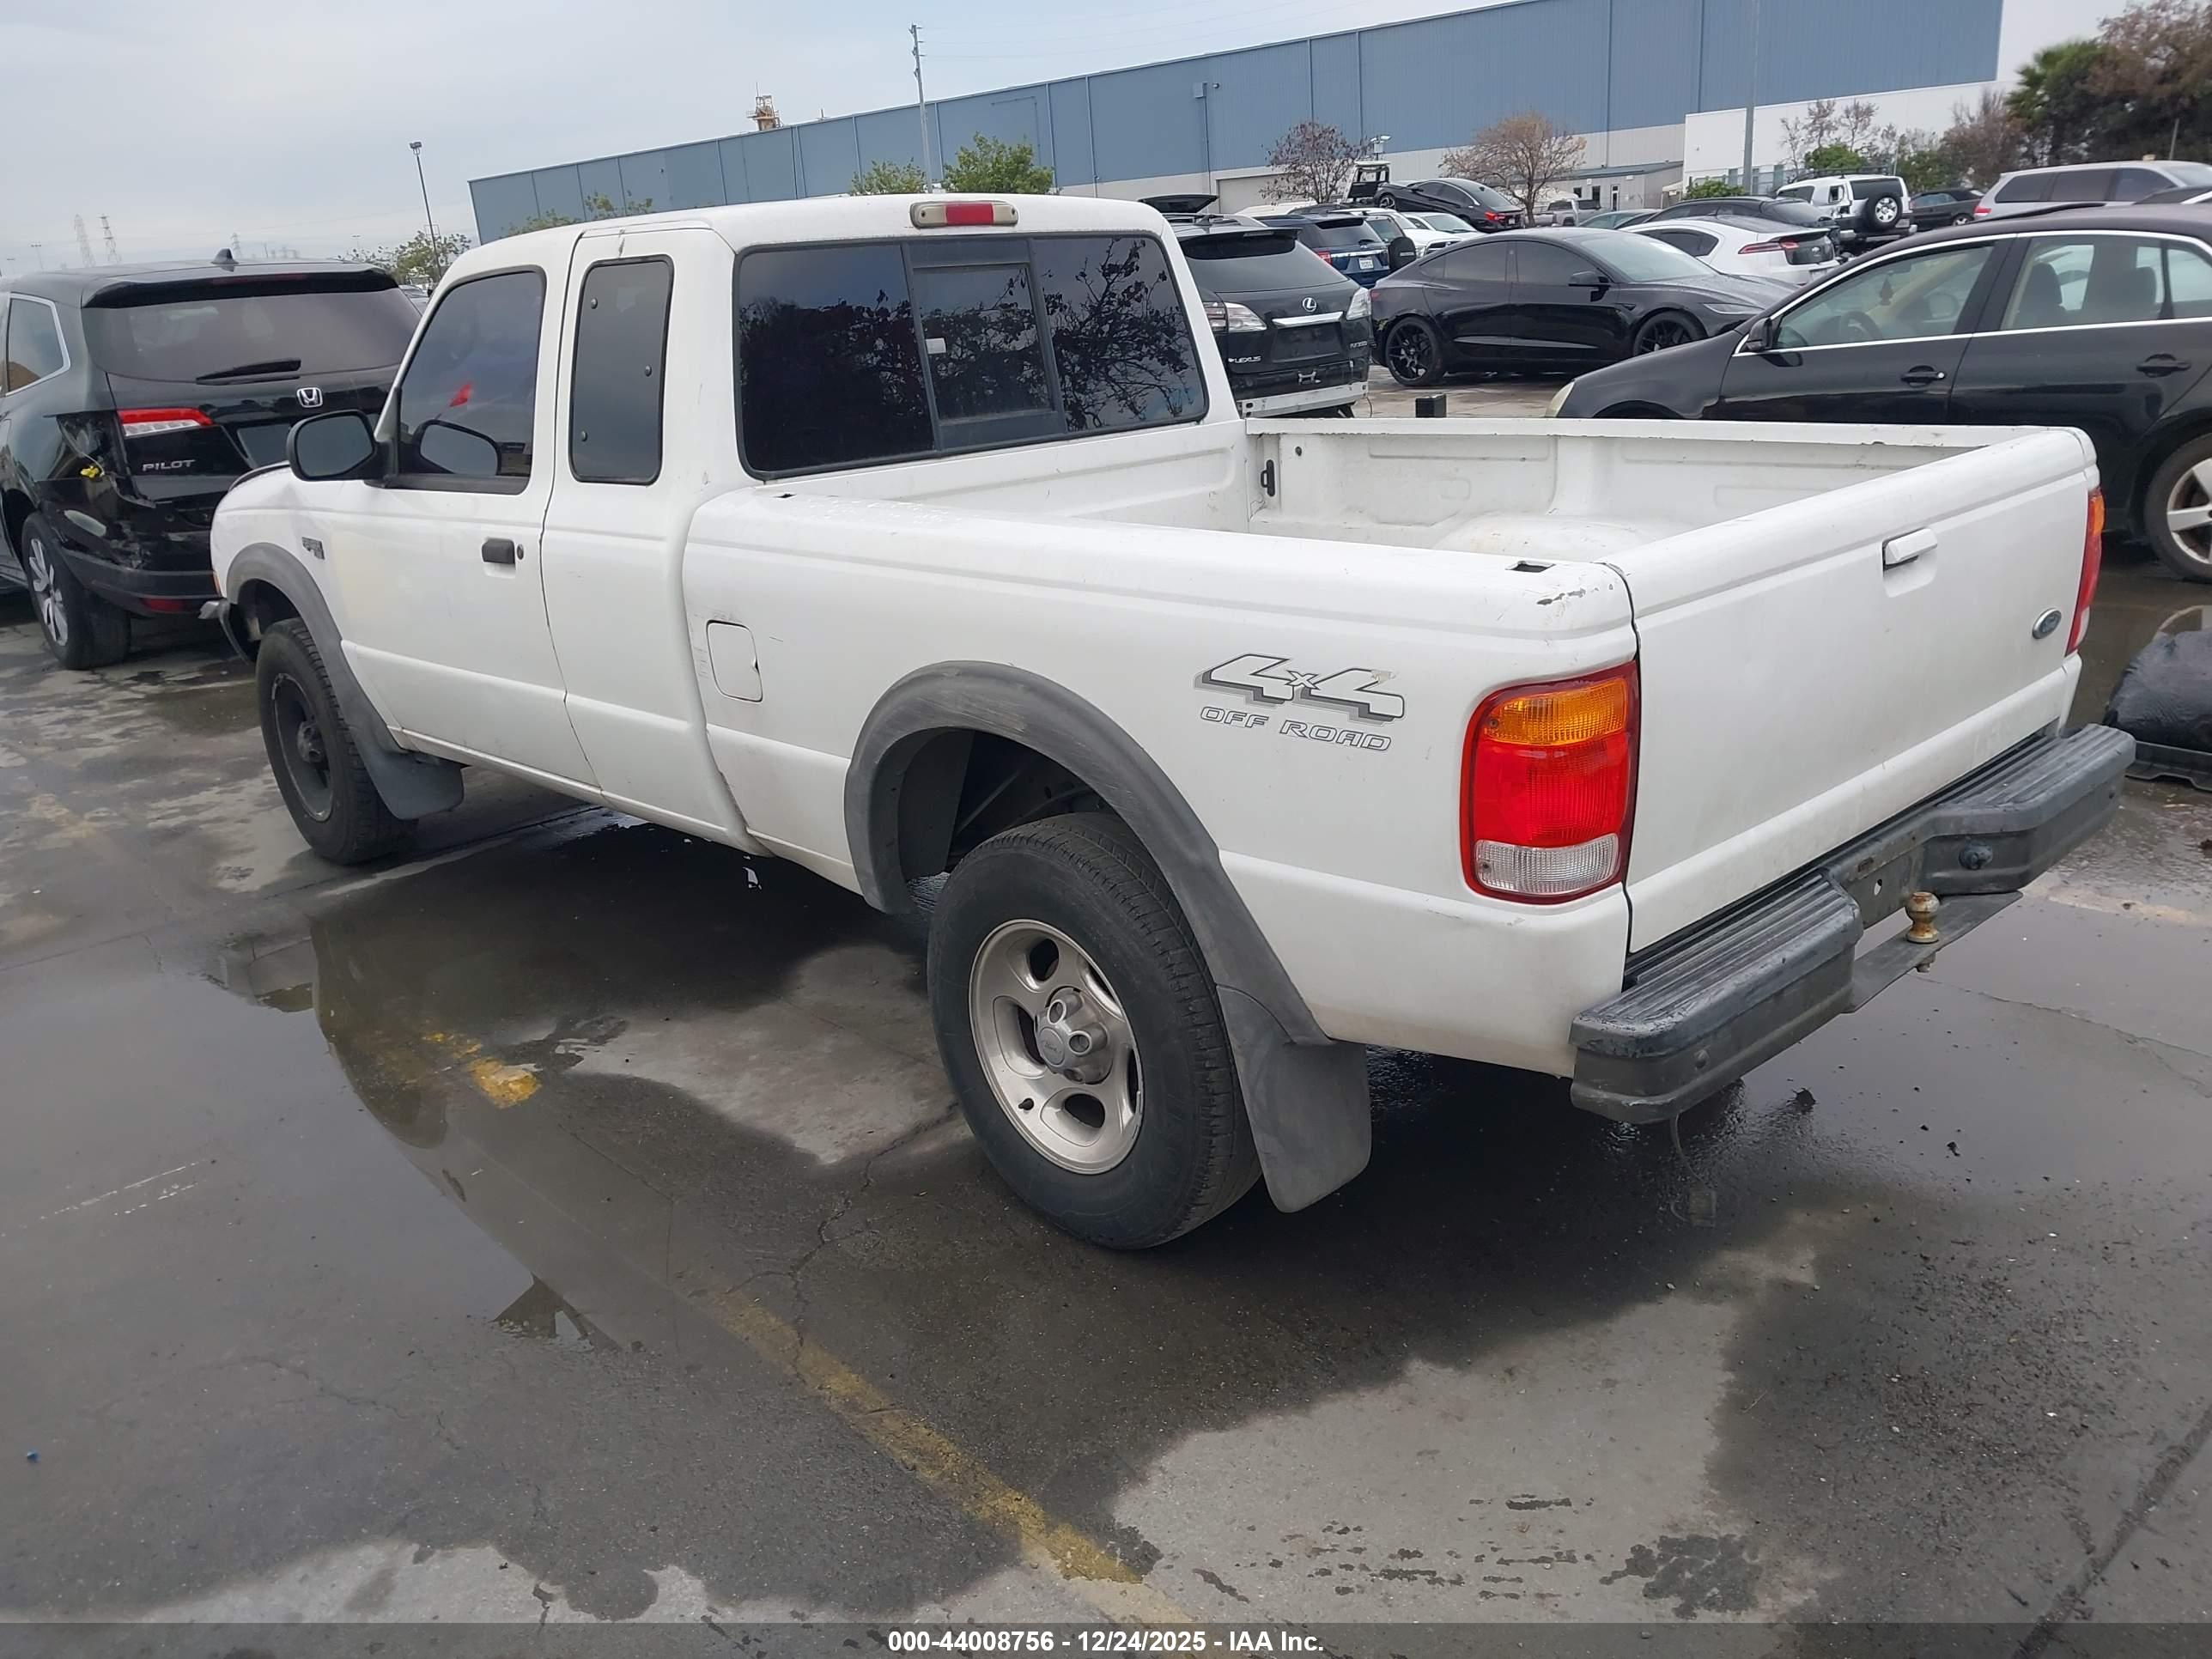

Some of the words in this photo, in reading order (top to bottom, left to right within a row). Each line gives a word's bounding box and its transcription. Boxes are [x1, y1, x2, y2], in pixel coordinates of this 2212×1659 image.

[143, 459, 196, 471] PILOT
[1200, 706, 1269, 728] OFF
[1279, 720, 1392, 751] ROAD
